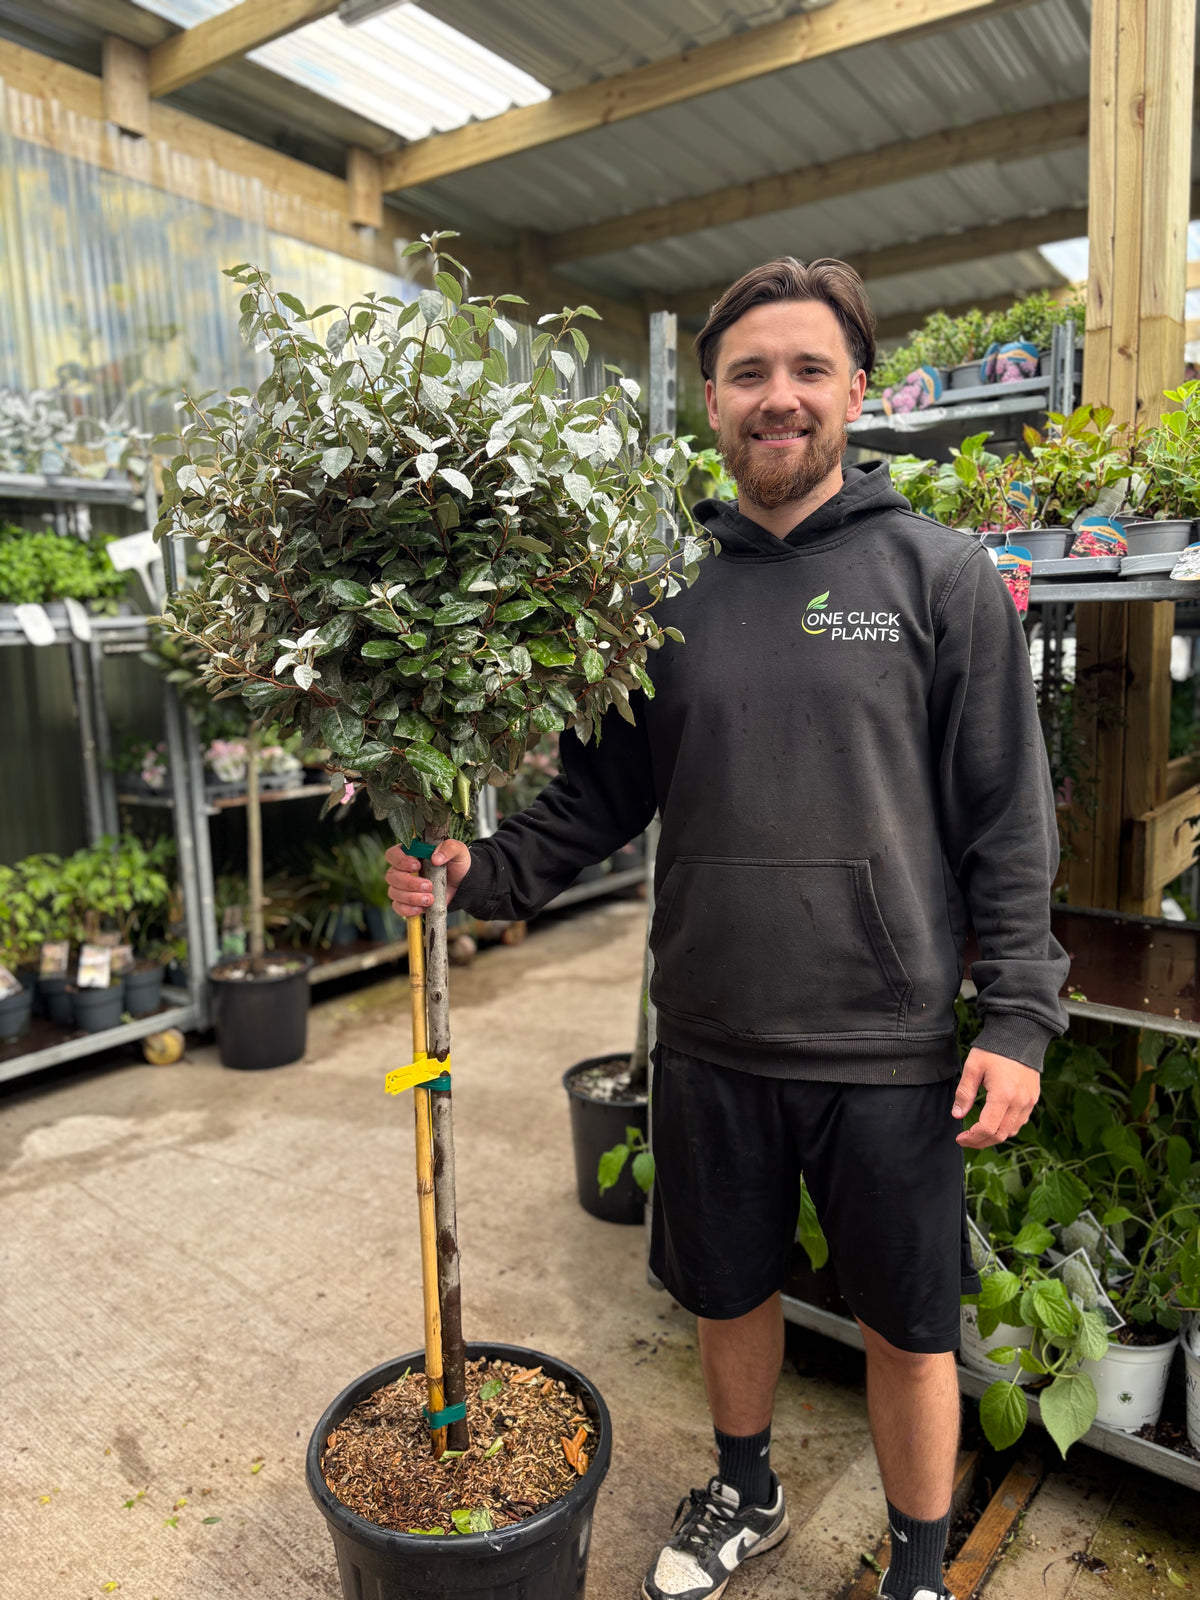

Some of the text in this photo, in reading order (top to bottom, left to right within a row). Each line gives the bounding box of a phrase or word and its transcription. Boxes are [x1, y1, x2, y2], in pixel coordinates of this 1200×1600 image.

[807, 611, 900, 627] ONE CLICK
[831, 627, 900, 643] PLANTS
